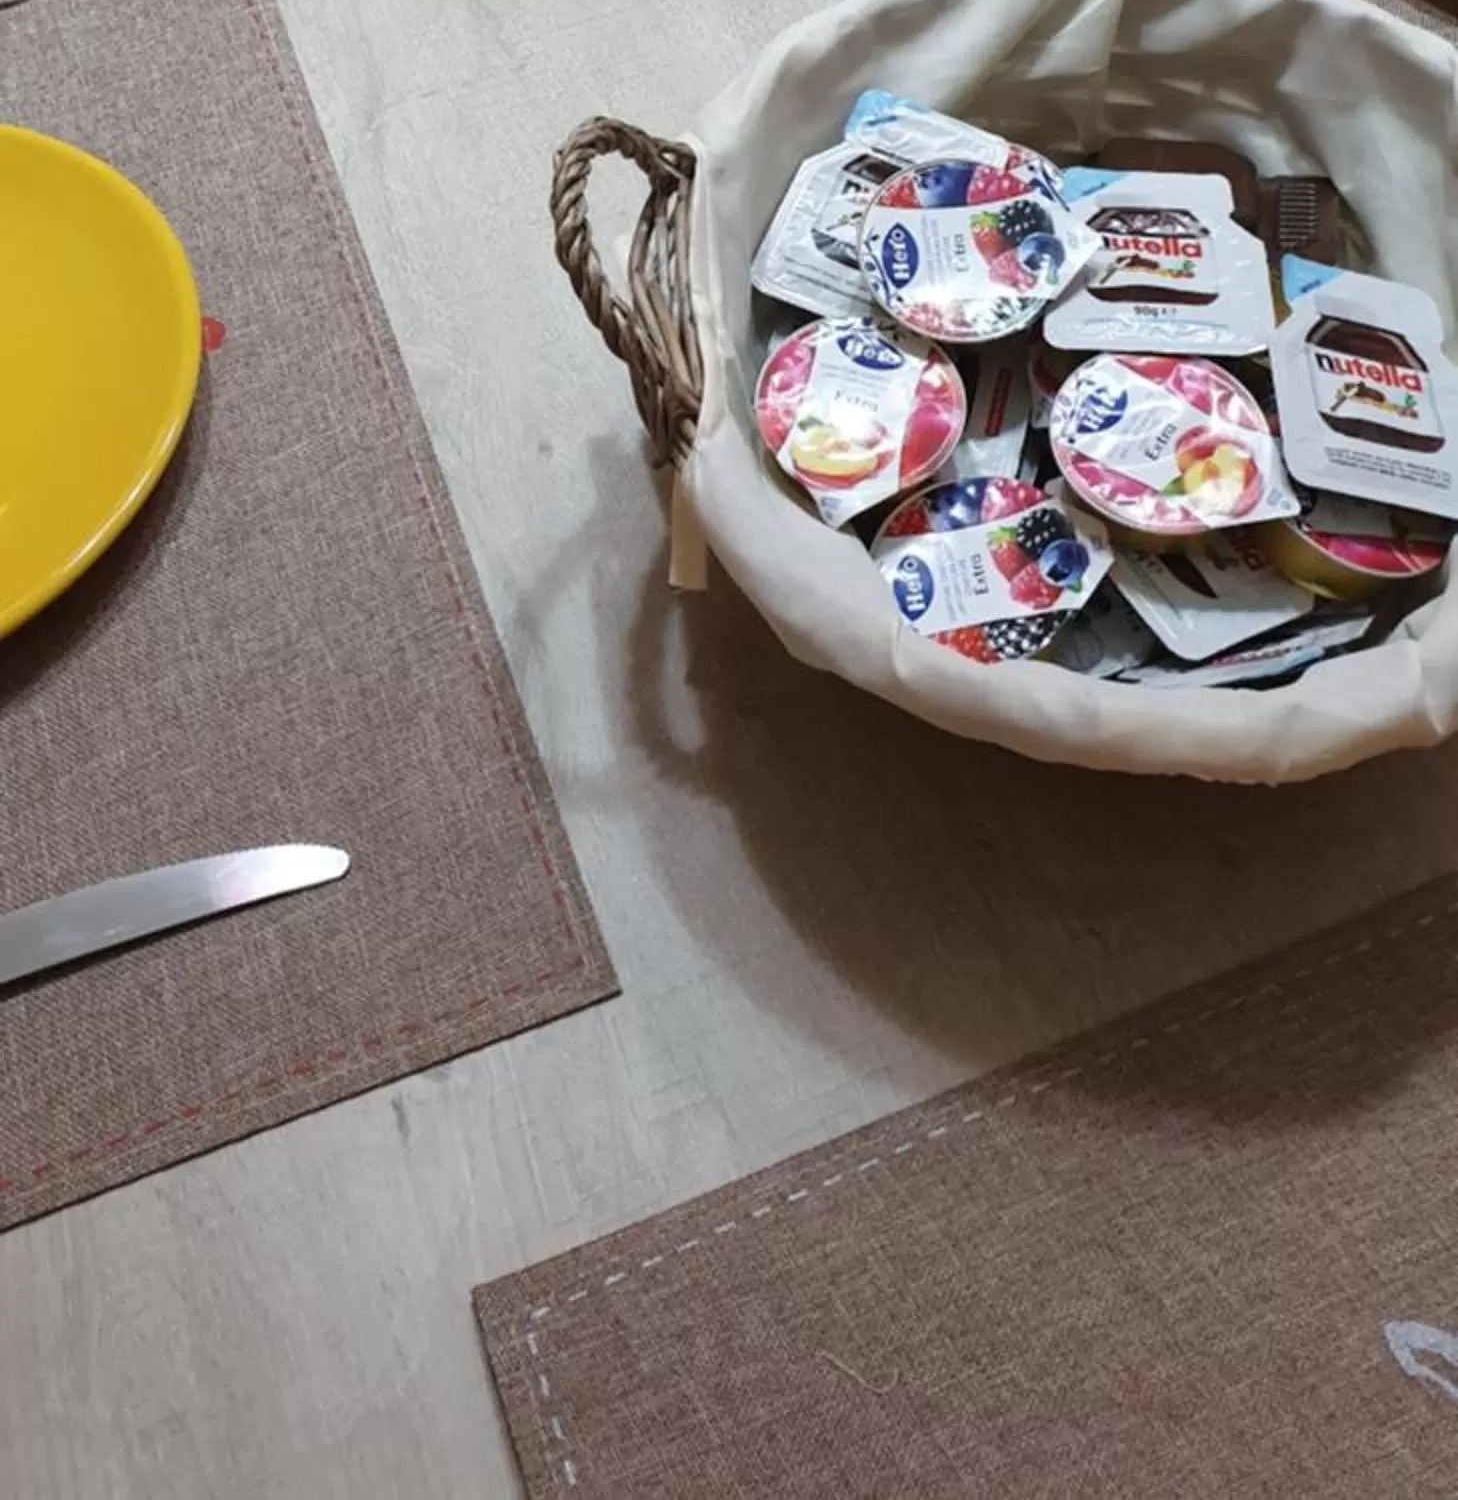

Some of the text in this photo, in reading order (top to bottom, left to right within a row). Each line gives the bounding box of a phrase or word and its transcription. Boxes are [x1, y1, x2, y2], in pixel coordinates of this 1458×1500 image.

[887, 228, 911, 280] Hero
[1314, 352, 1423, 393] nutella
[1143, 423, 1178, 462] Extra
[902, 558, 925, 613] Hero
[970, 553, 990, 595] Extra
